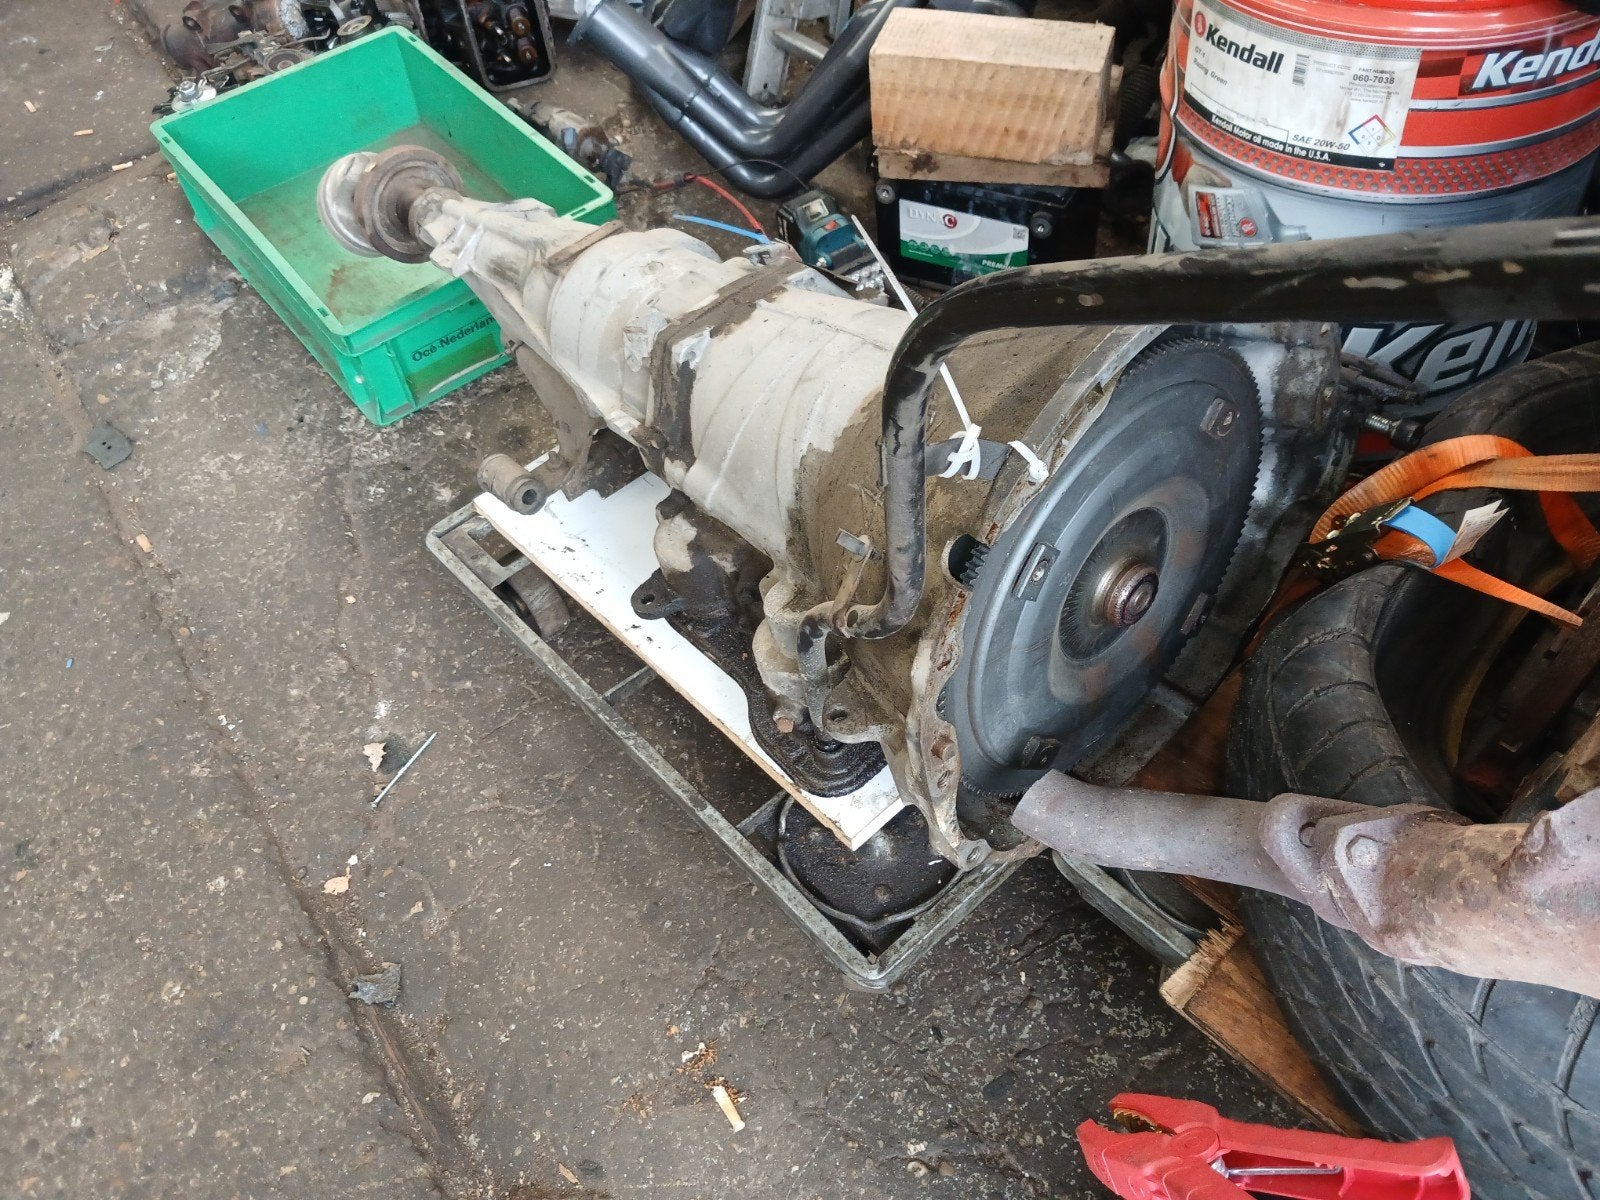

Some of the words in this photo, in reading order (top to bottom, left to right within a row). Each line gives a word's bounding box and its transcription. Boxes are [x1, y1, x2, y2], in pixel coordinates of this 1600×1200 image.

[1205, 23, 1285, 74] Kendall
[1471, 27, 1600, 89] Kend
[1210, 71, 1228, 86] Green
[1352, 74, 1395, 85] 060-7038
[1211, 114, 1233, 133] Kendall
[1233, 125, 1253, 141] Motor
[1252, 135, 1262, 144] oil
[1262, 138, 1284, 151] made
[1285, 143, 1293, 153] in
[1293, 146, 1307, 157] the
[1308, 149, 1331, 162] U.S.A.
[1292, 134, 1312, 145] SAE
[1313, 139, 1351, 151] 20W-50
